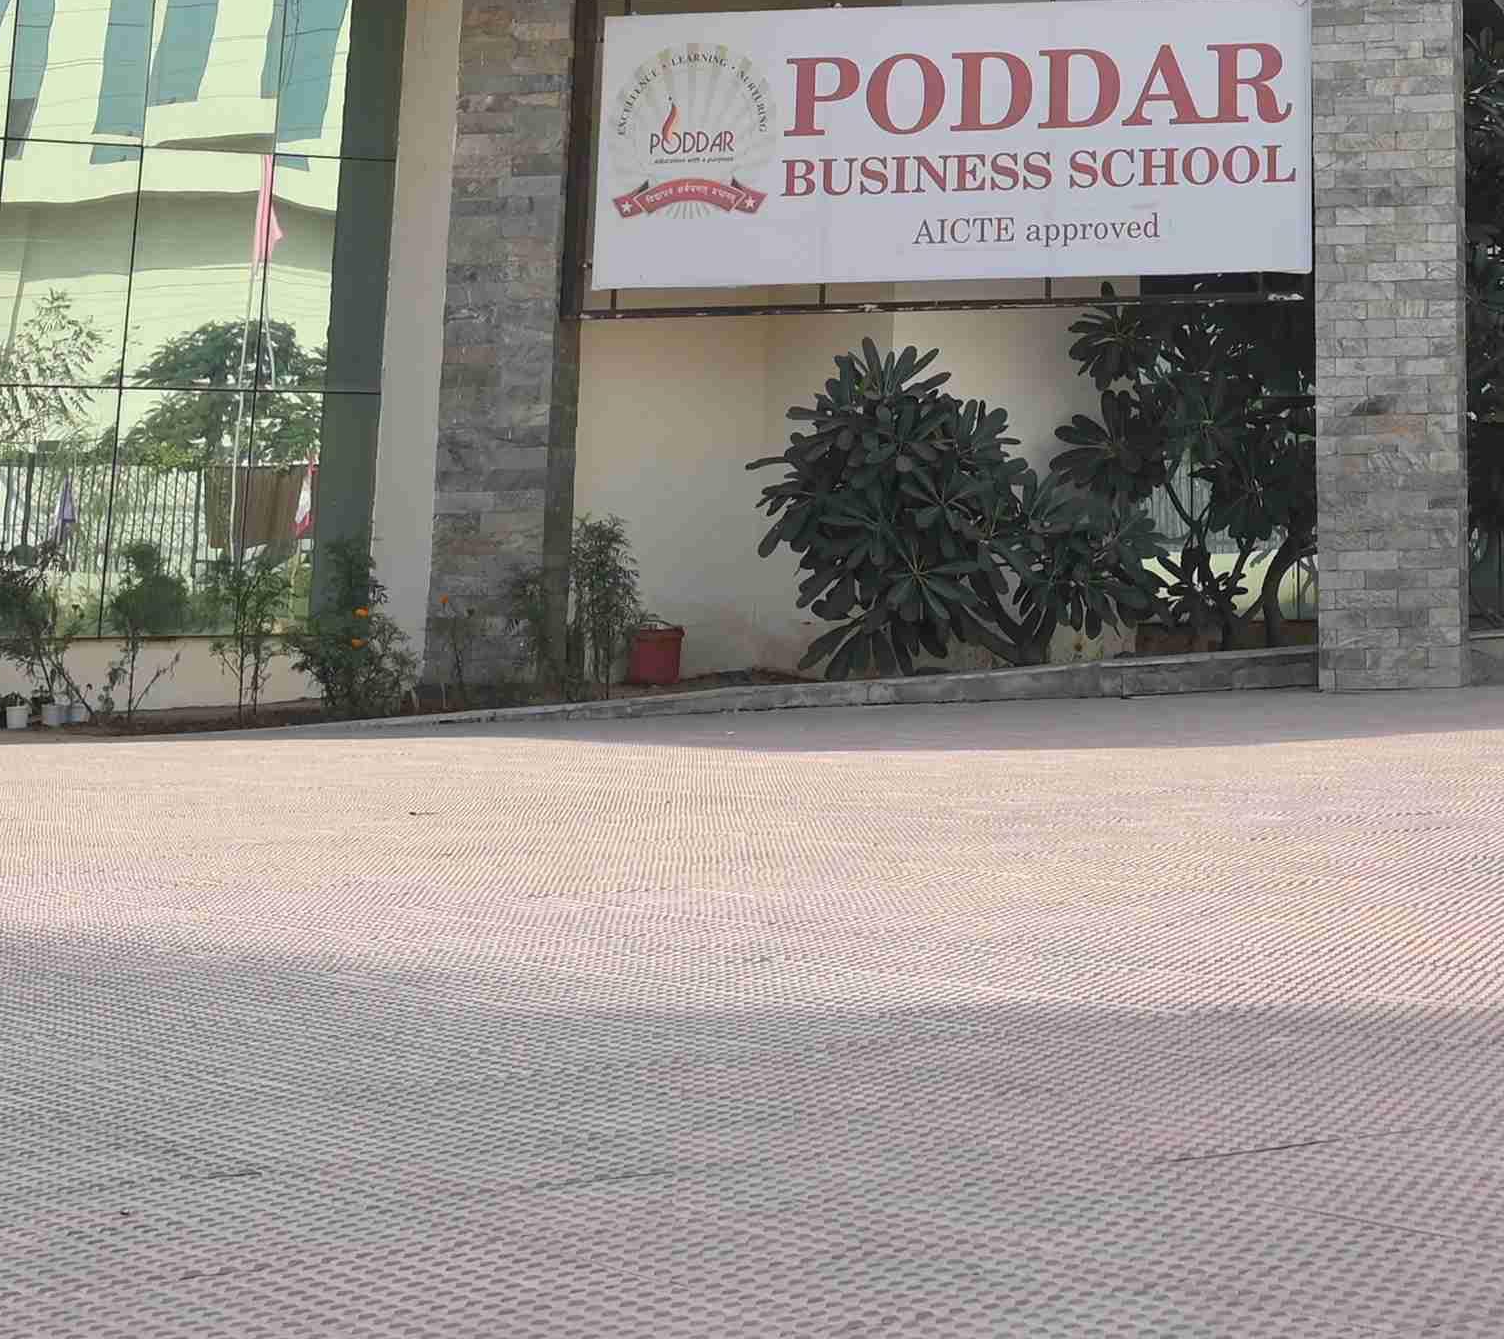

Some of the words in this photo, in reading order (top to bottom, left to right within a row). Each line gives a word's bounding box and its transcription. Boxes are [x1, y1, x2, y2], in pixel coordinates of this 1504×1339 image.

[671, 53, 728, 68] LEARNING
[783, 42, 1293, 138] PODDAR
[649, 130, 735, 155] PODDAR
[780, 152, 1053, 198] BUSINESS
[1069, 144, 1297, 190] SCHOOL
[912, 216, 1016, 245] AICTE
[1024, 211, 1161, 248] approved
